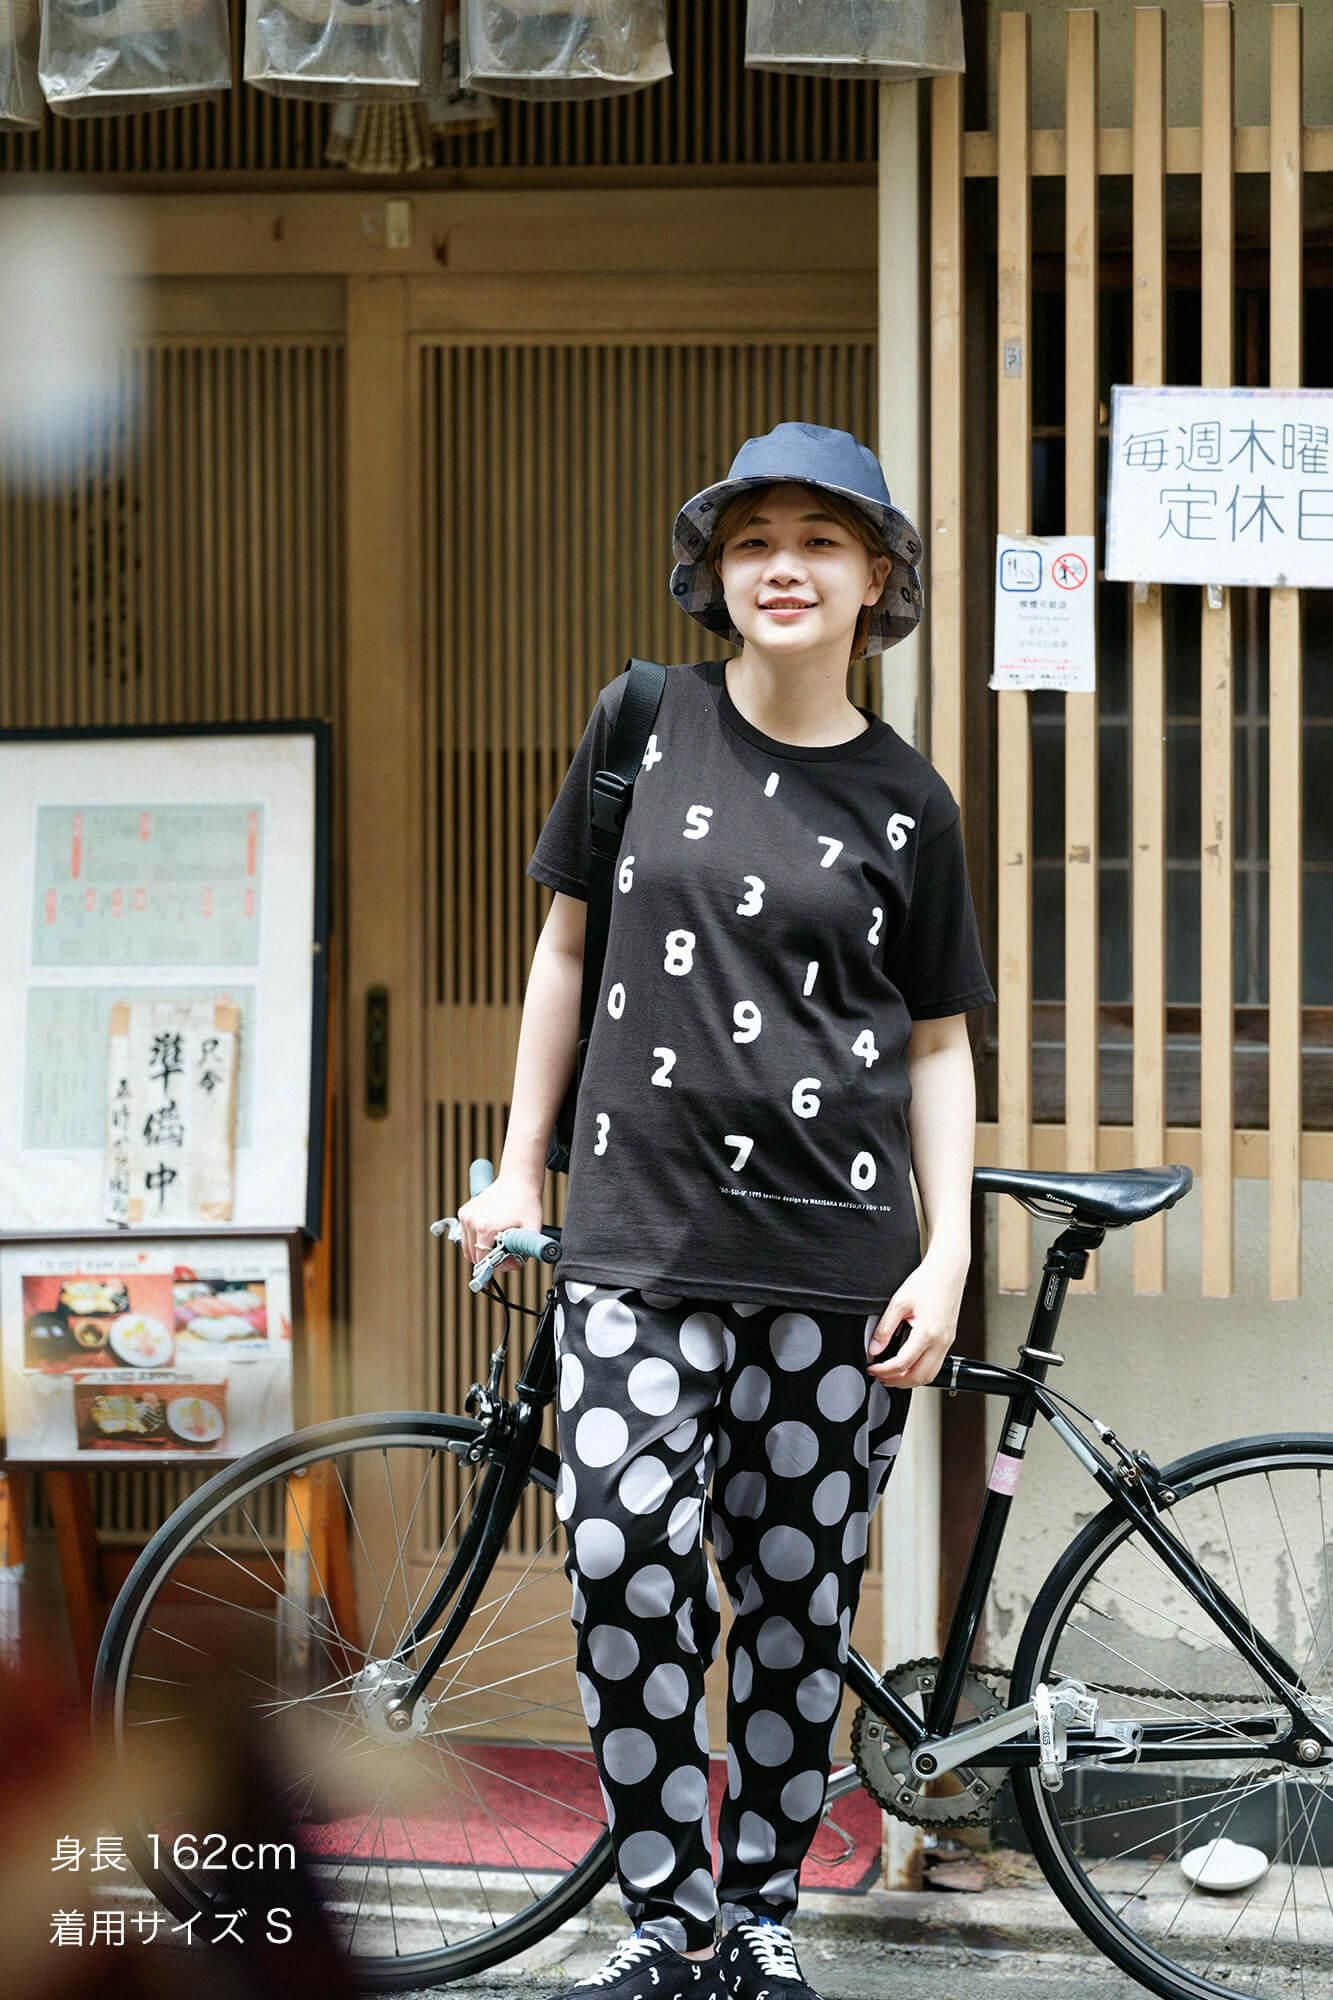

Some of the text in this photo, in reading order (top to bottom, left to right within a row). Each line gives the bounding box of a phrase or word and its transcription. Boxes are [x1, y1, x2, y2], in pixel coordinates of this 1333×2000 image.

[1122, 419, 1329, 475] 毎週木曜
[1158, 482, 1333, 544] 定休日
[763, 772, 780, 798] 1
[682, 804, 713, 840] 5
[886, 812, 916, 851] 6
[817, 835, 844, 869] 7
[618, 855, 636, 894] 6
[735, 875, 766, 917] 3
[866, 906, 884, 946] 2
[663, 928, 696, 977] 8
[802, 960, 819, 997] 1
[607, 982, 626, 1020] 0
[732, 1000, 763, 1044] 9
[650, 1046, 677, 1089] 2
[850, 1028, 880, 1068] 4
[791, 1077, 822, 1120] 6
[593, 1112, 611, 1157] 3
[724, 1134, 754, 1172] 7
[850, 1151, 878, 1191] 0
